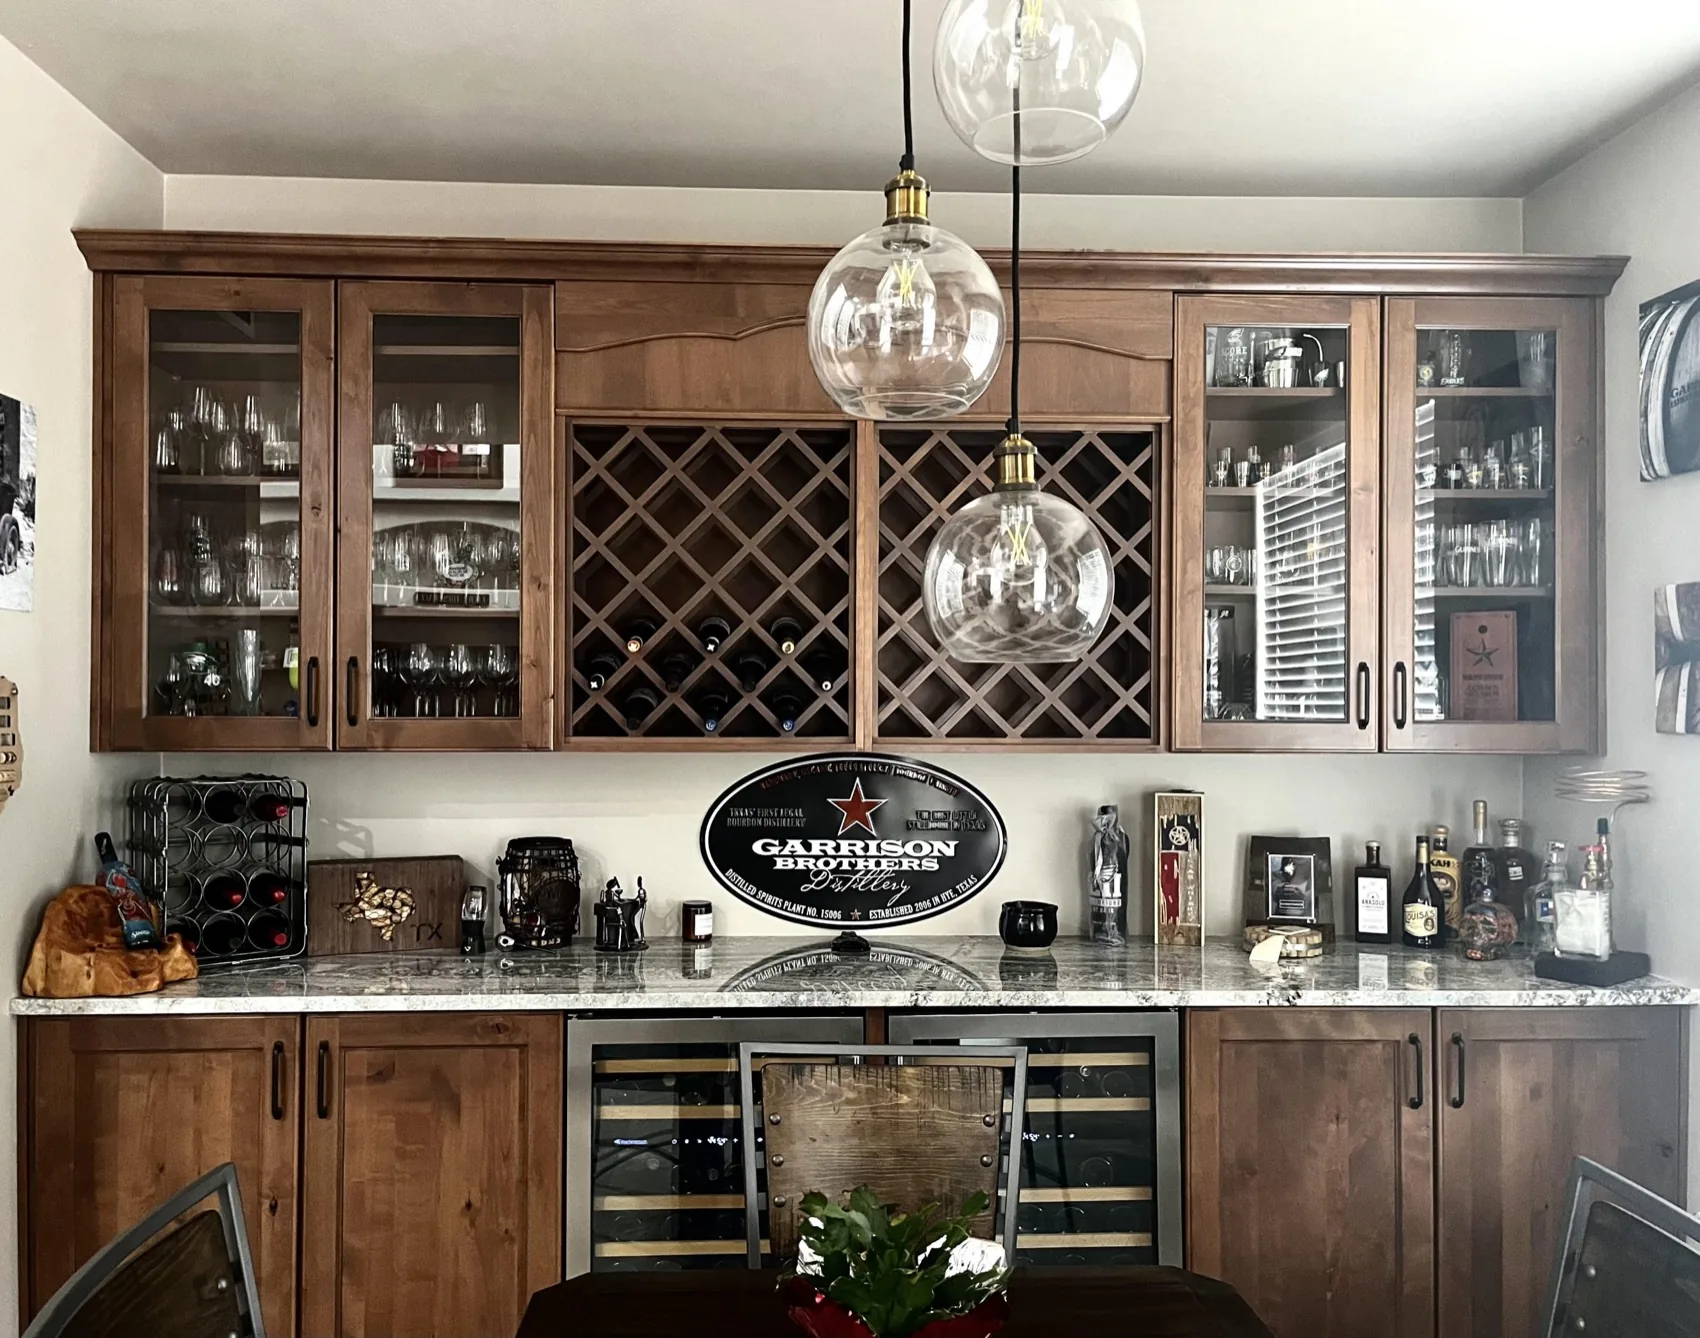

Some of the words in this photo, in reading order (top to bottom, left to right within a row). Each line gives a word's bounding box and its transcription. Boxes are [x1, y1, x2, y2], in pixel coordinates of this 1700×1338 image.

[727, 817, 762, 828] BOURBON
[763, 818, 807, 828] DISTILLERY
[752, 839, 959, 857] GARRISON
[773, 857, 939, 871] BROTHERS
[1430, 859, 1451, 868] KAH
[725, 868, 757, 895] DISTILLED
[756, 890, 783, 908] SPIRITS
[783, 900, 806, 915] PLANT
[806, 906, 819, 918] NO.
[820, 909, 842, 920] 15006
[800, 868, 911, 907] Distillery
[869, 904, 914, 920] ESTABLISHED
[914, 899, 932, 912] 2006
[931, 895, 941, 906] IN
[940, 888, 958, 903] HYE,
[955, 874, 978, 894] TEXAS
[410, 922, 443, 942] TX
